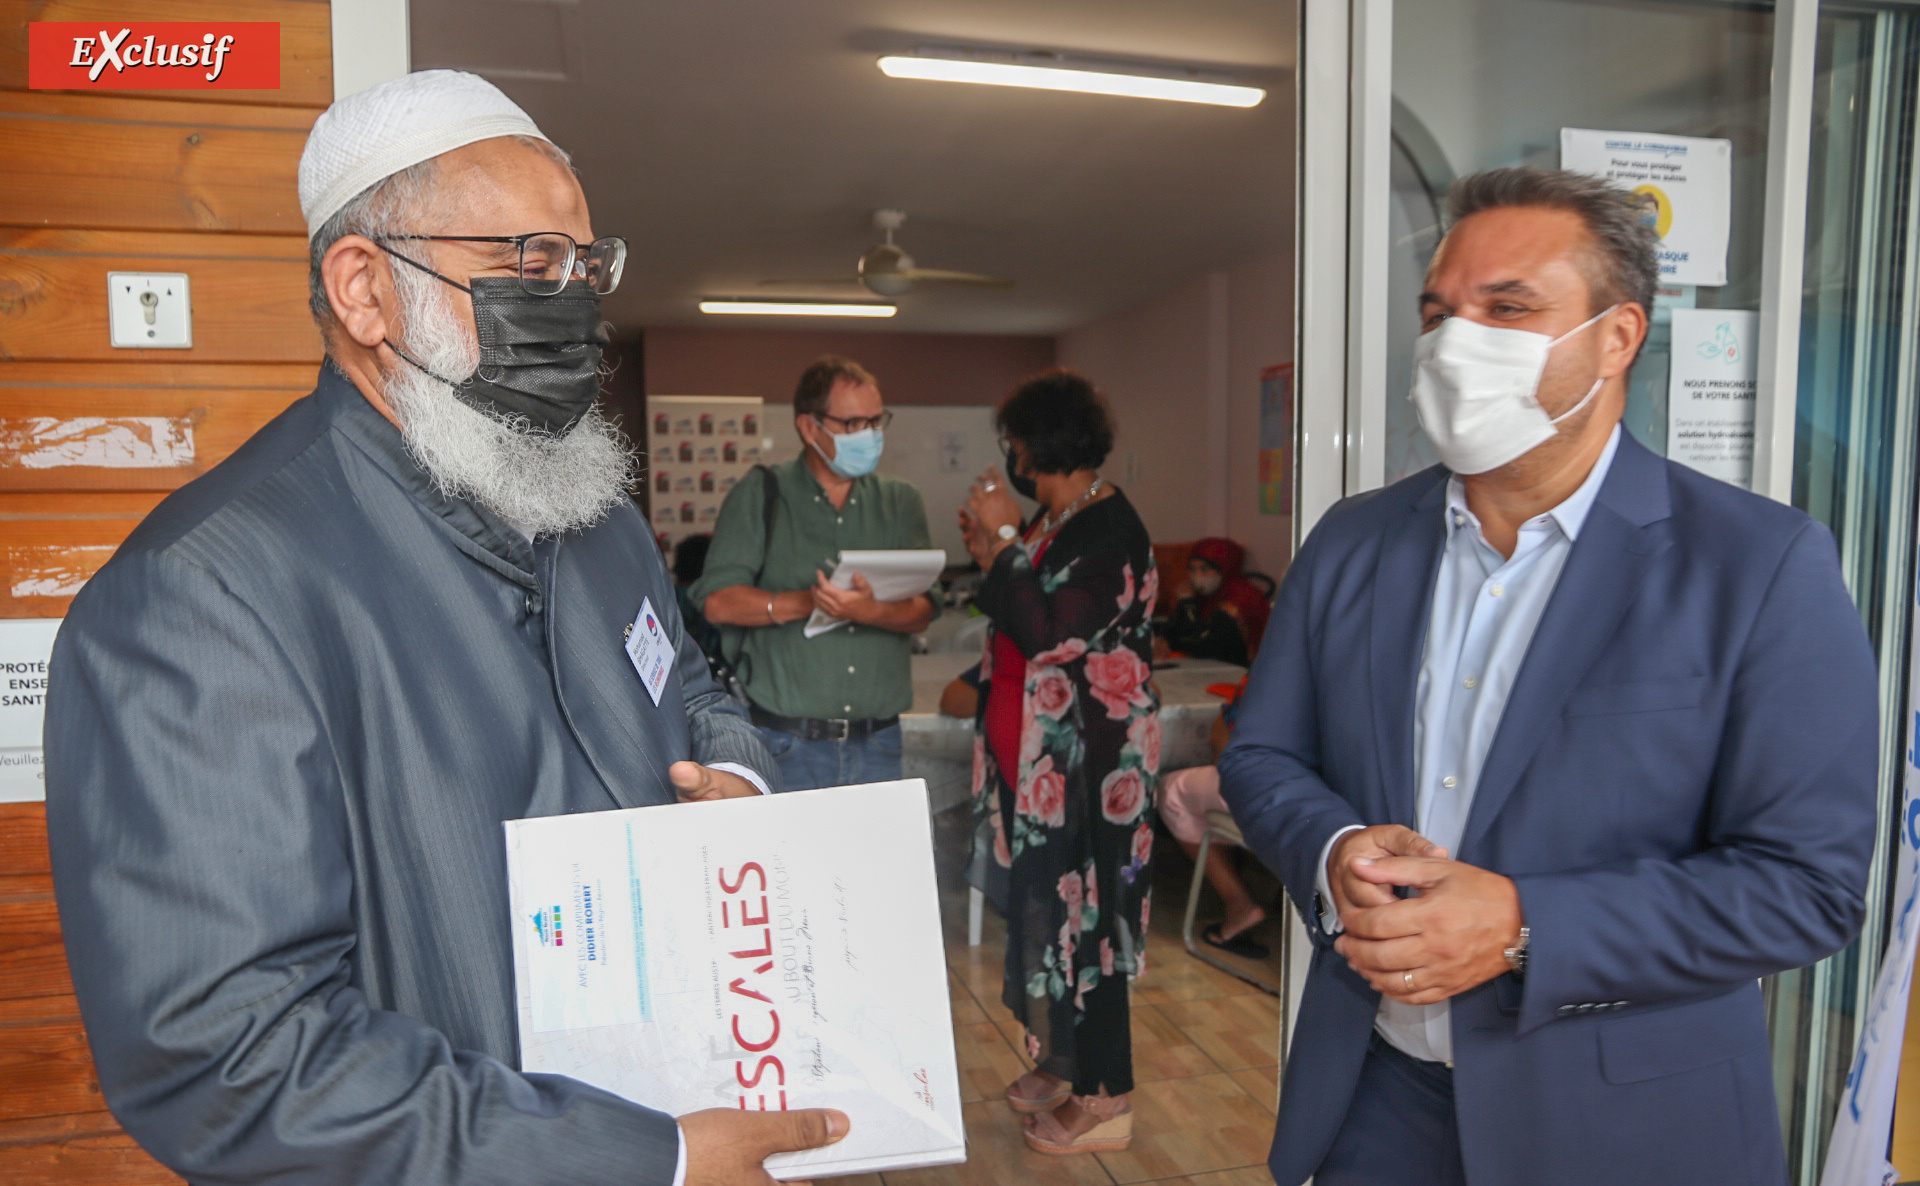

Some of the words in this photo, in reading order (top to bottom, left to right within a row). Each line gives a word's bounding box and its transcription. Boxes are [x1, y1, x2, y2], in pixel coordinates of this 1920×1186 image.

[1611, 158, 1629, 166] Pour
[1684, 380, 1706, 388] NOUS
[1709, 380, 1745, 388] PRENONS
[1692, 391, 1703, 399] DE
[1706, 391, 1730, 399] VOTRE
[0, 660, 50, 673] PROTÉ
[583, 884, 594, 924] ROBERT
[778, 904, 795, 930] DU
[575, 946, 586, 961] LES
[586, 927, 597, 961] DIDIER
[779, 937, 798, 982] BOUT
[577, 963, 588, 987] AVEC
